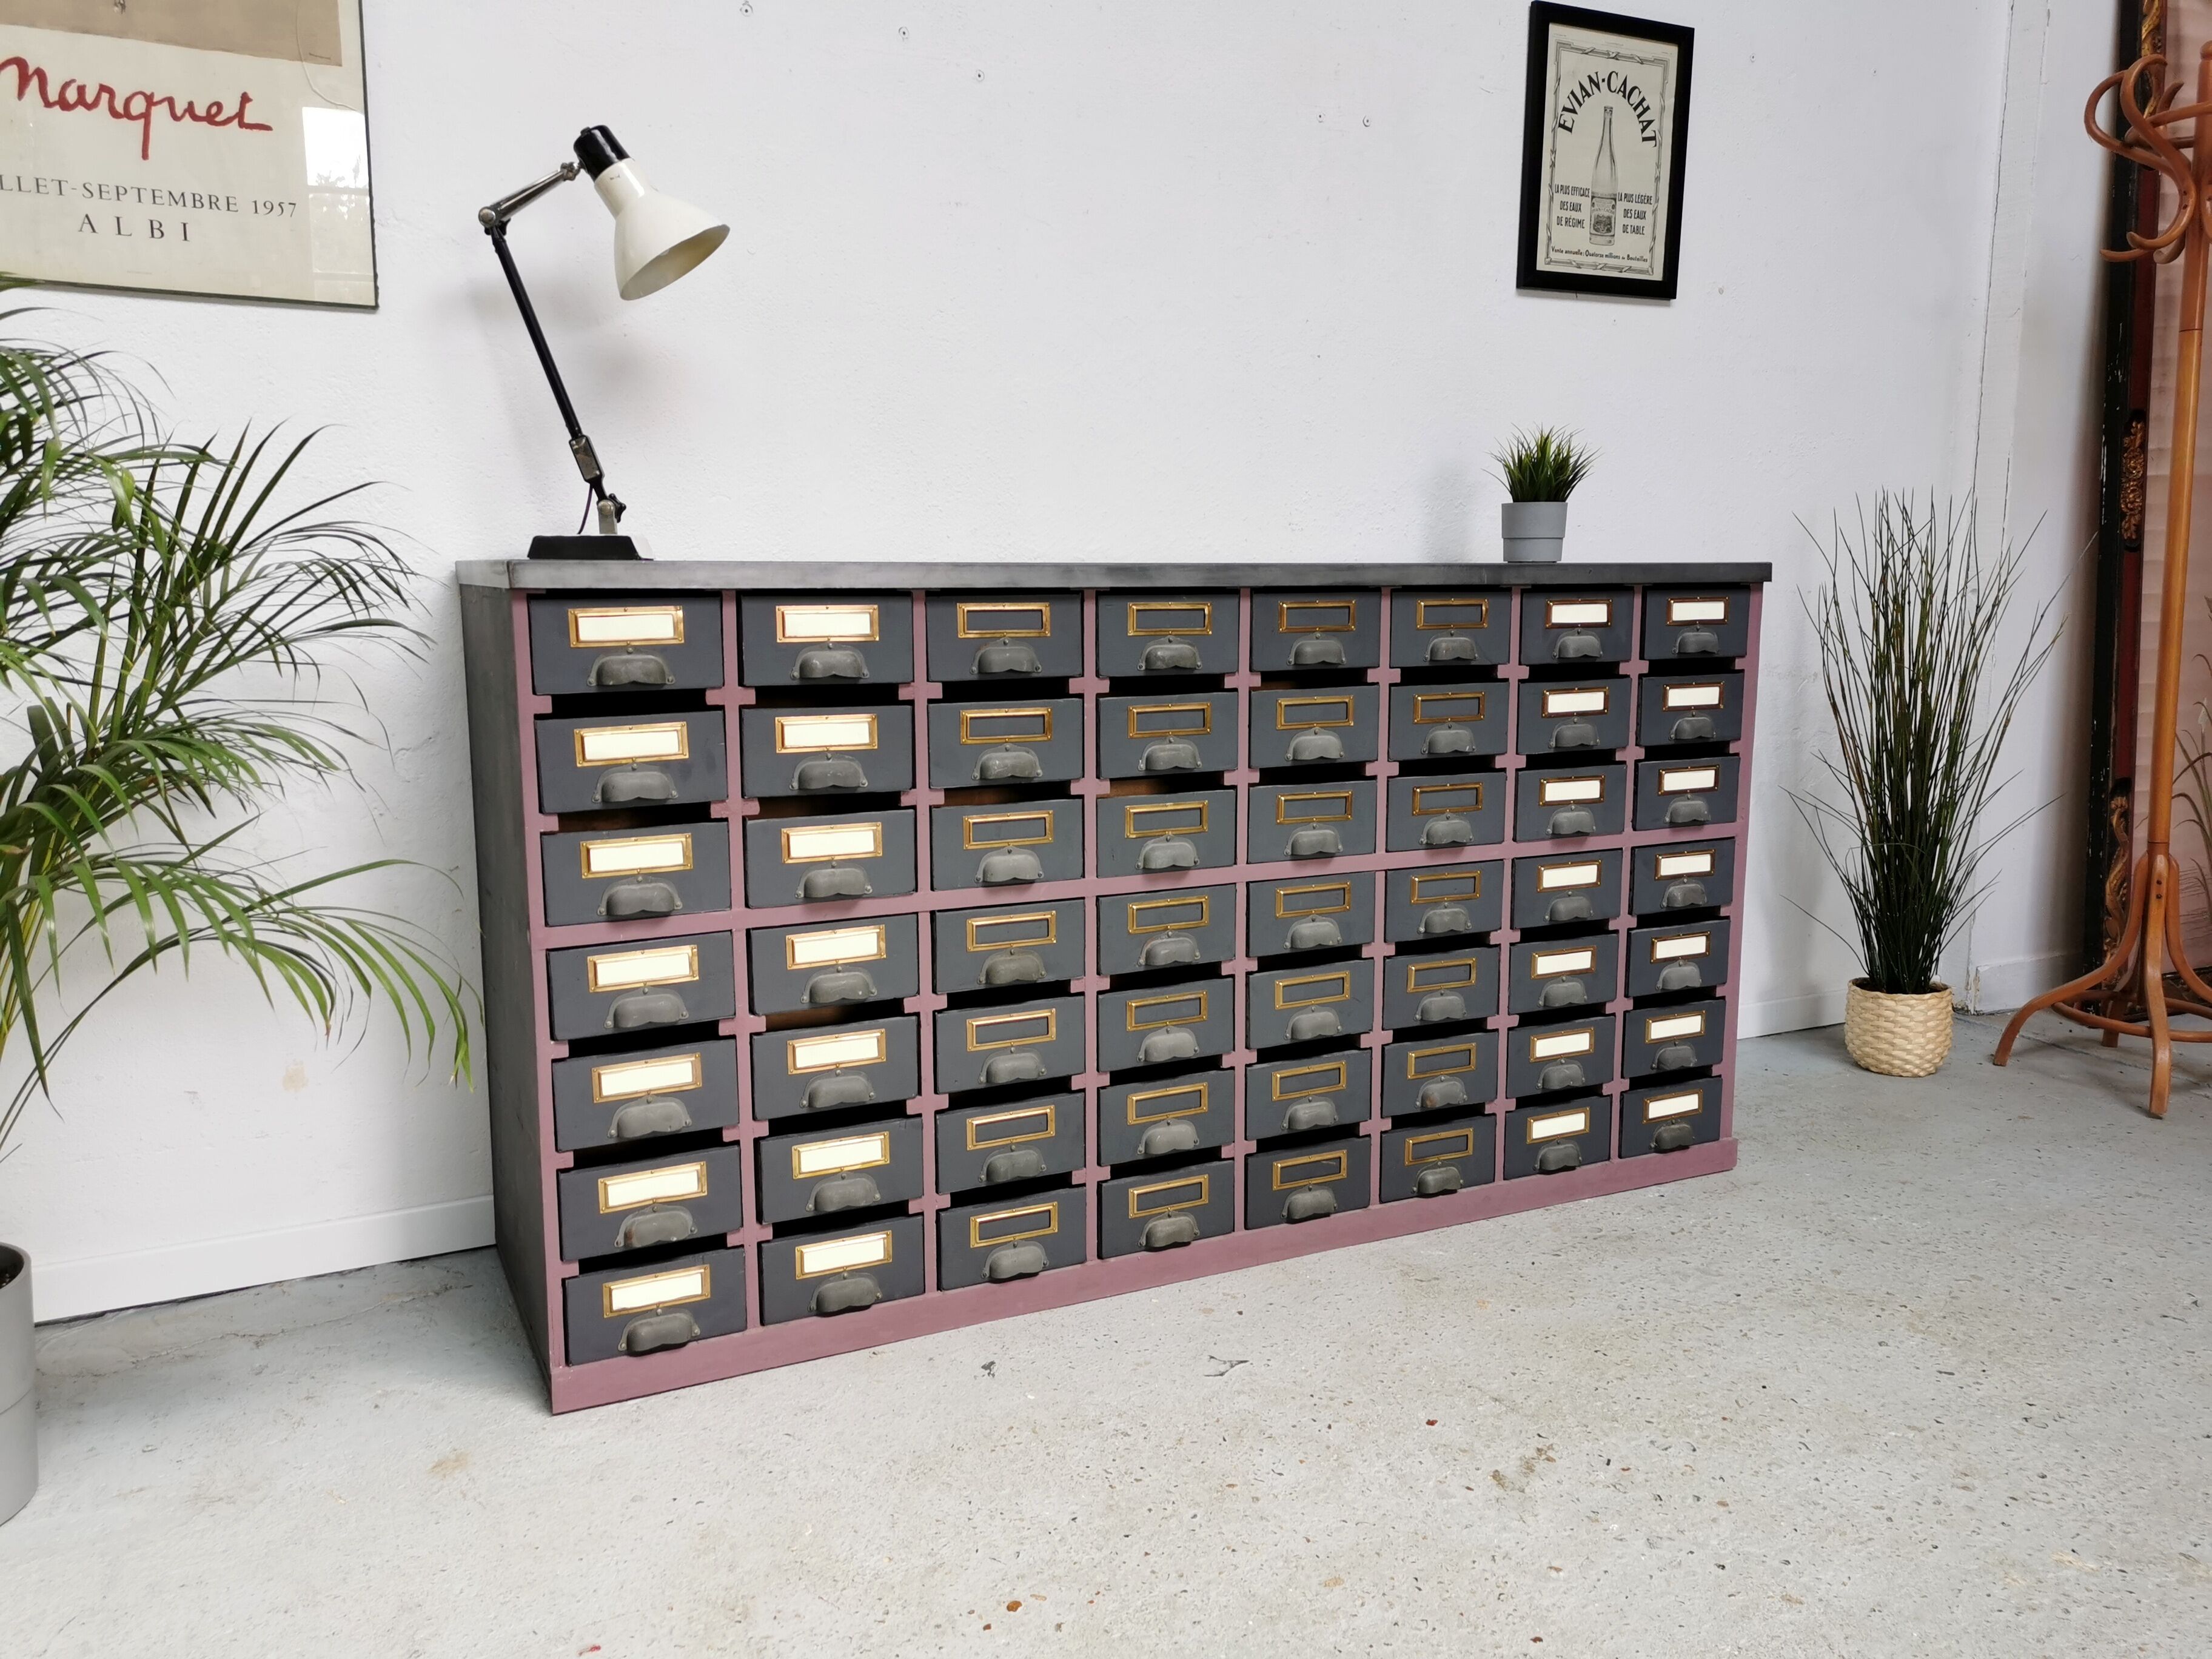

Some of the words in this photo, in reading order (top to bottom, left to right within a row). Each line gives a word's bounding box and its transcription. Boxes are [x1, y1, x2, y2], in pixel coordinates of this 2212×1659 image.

[1555, 184, 1560, 193] LA
[1560, 184, 1570, 195] PLUS
[1571, 186, 1590, 198] EFFICACE
[1618, 192, 1623, 202] LA
[1623, 193, 1634, 203] PLUS
[252, 199, 297, 218] 1957
[1560, 200, 1569, 211] DES
[1569, 201, 1582, 213] EAUX
[1557, 215, 1563, 226] DE
[1623, 209, 1633, 219] DES
[1634, 209, 1647, 220] EAUX
[78, 213, 191, 242] ALBI
[1622, 224, 1629, 233] DE
[1630, 224, 1645, 235] TABLE
